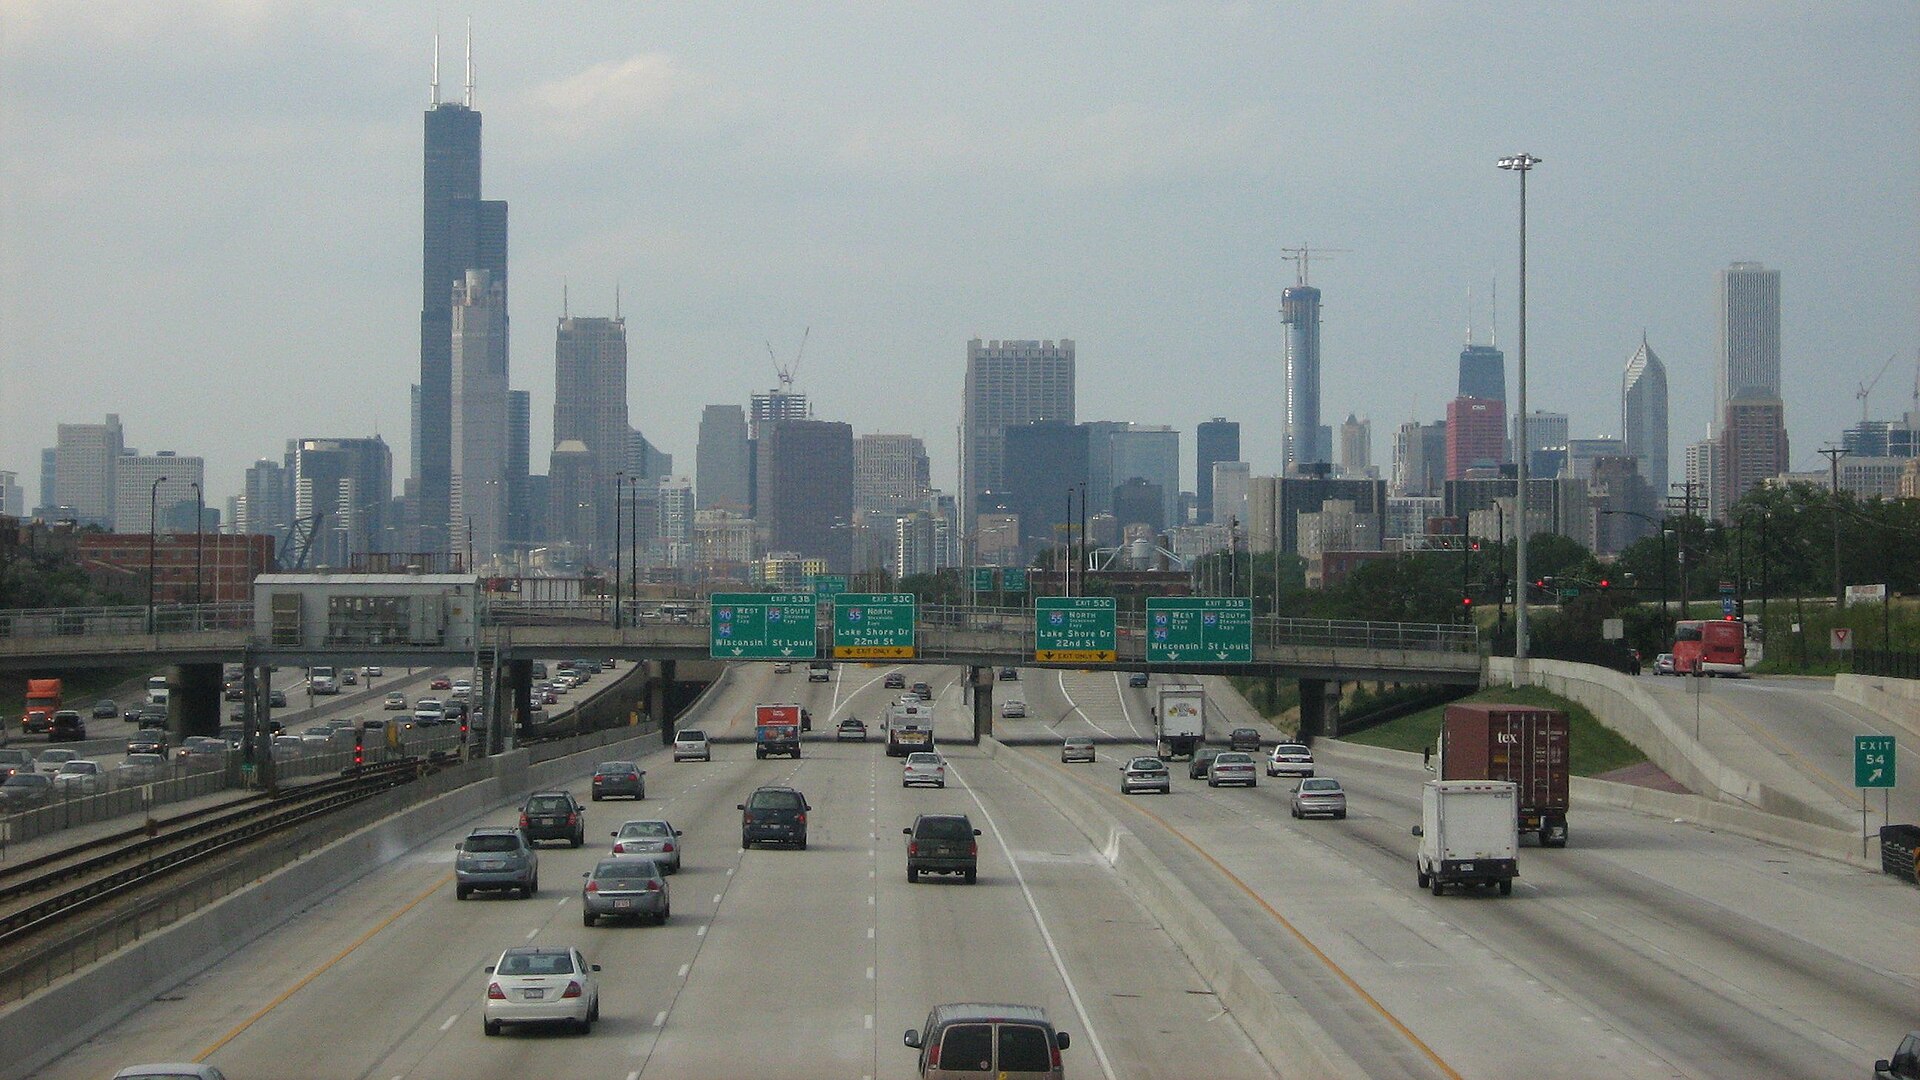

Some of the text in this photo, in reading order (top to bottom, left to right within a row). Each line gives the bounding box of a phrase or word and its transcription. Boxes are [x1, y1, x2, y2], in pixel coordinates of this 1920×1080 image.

[720, 610, 732, 619] 90
[768, 610, 780, 619] 55
[849, 612, 861, 620] 55
[1051, 615, 1062, 623] 55
[1155, 615, 1167, 624] 90
[1497, 731, 1518, 743] tex
[1860, 742, 1890, 750] EXIT
[1866, 754, 1884, 764] 54
